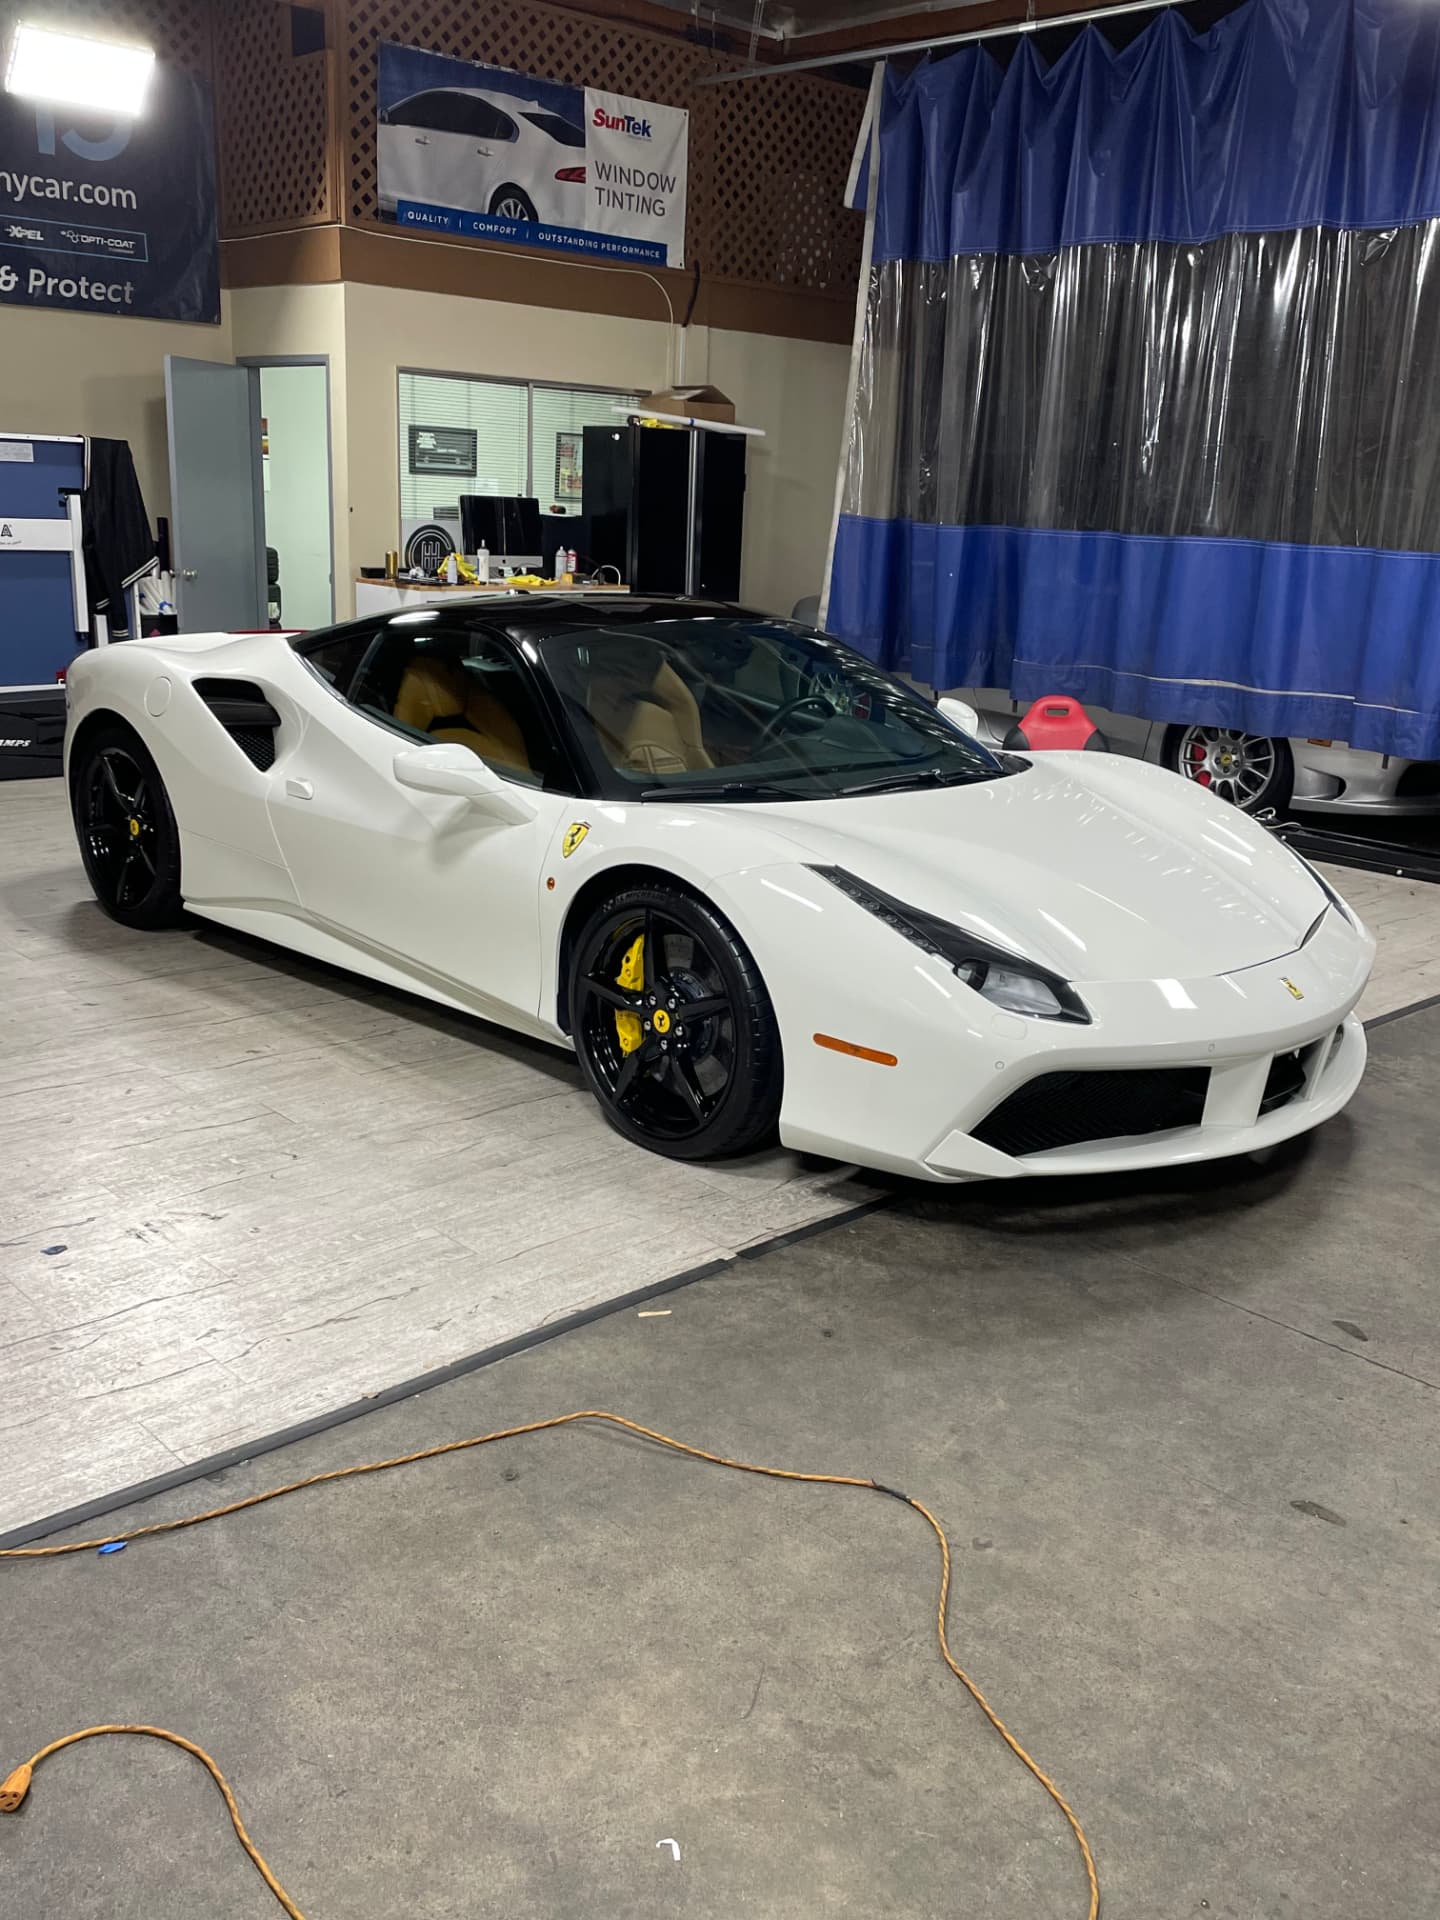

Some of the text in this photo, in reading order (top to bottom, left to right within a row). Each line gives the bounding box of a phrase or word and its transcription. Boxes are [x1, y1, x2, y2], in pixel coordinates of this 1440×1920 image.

[593, 108, 653, 138] SunTek
[594, 160, 677, 194] WINDOW
[594, 186, 666, 217] TINTING
[8, 225, 136, 249] XPEL OPTI-COAT
[407, 211, 661, 258] QUALITY COMFORT OUTSTANDING PERFORMANCE
[0, 265, 134, 304] & Protect
